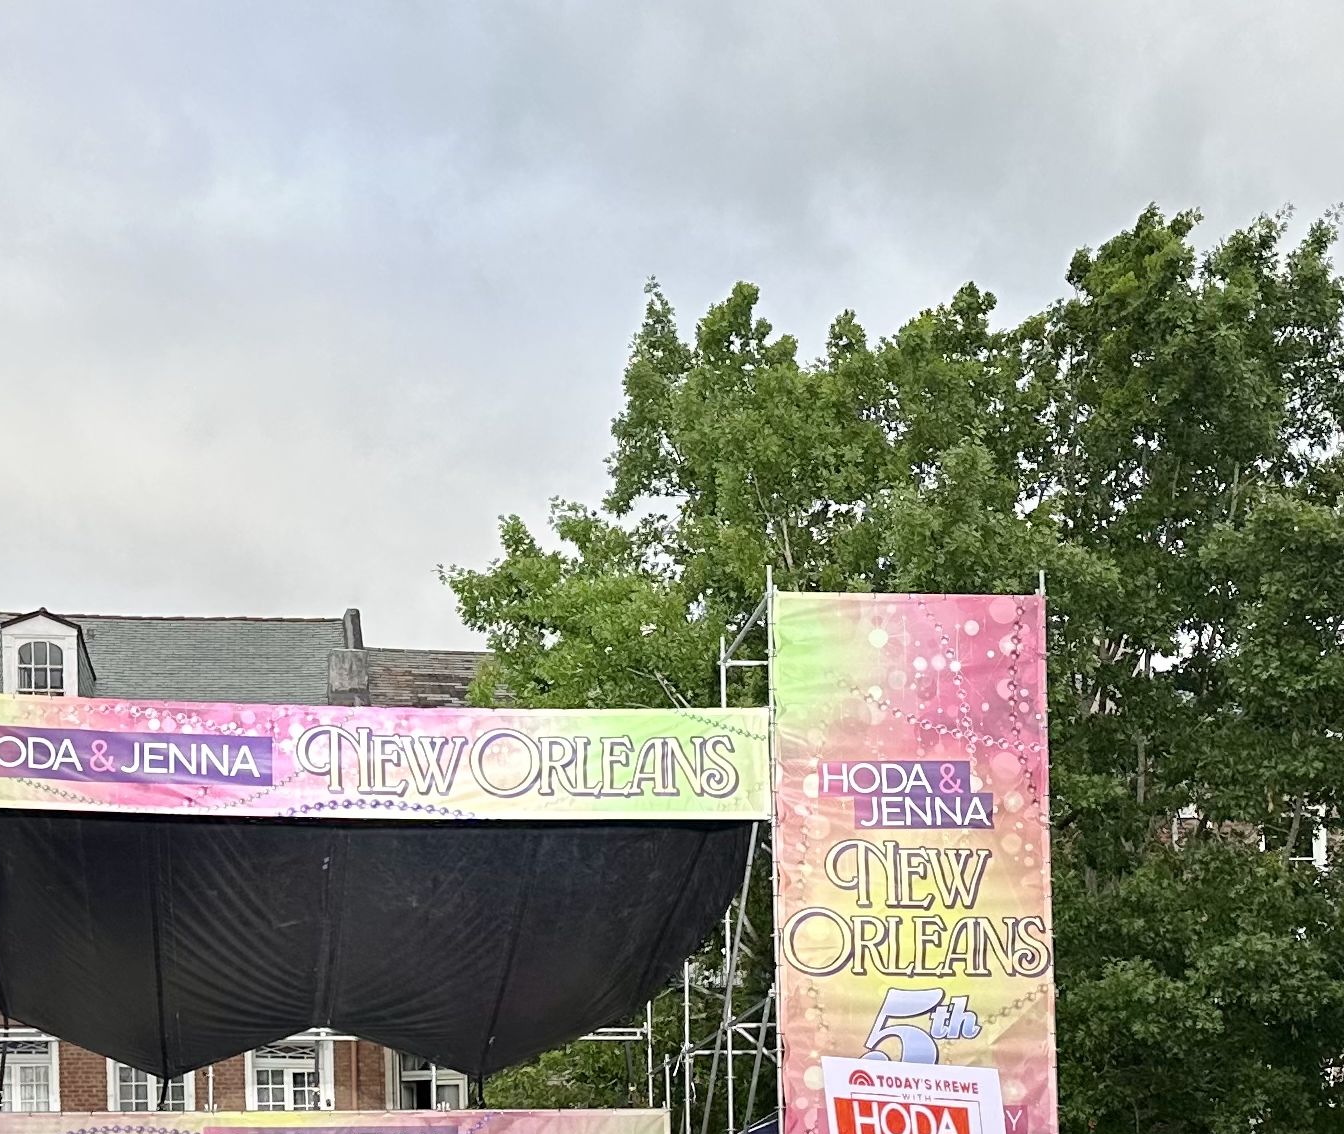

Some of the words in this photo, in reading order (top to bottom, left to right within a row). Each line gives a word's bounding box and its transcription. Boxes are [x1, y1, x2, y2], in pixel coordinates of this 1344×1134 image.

[89, 739, 116, 773] &
[121, 742, 261, 778] JENNA
[296, 725, 467, 796] NEW
[469, 727, 739, 798] ORLEANS
[822, 763, 933, 795] HODA
[939, 762, 964, 795] &
[859, 796, 992, 827] JENNA
[824, 839, 993, 910] NEW
[782, 906, 1054, 977] ORLEANS
[857, 988, 982, 1065] 5th
[876, 1074, 932, 1091] TODAY'S
[935, 1079, 980, 1095] KREWE
[902, 1093, 932, 1102] WITH
